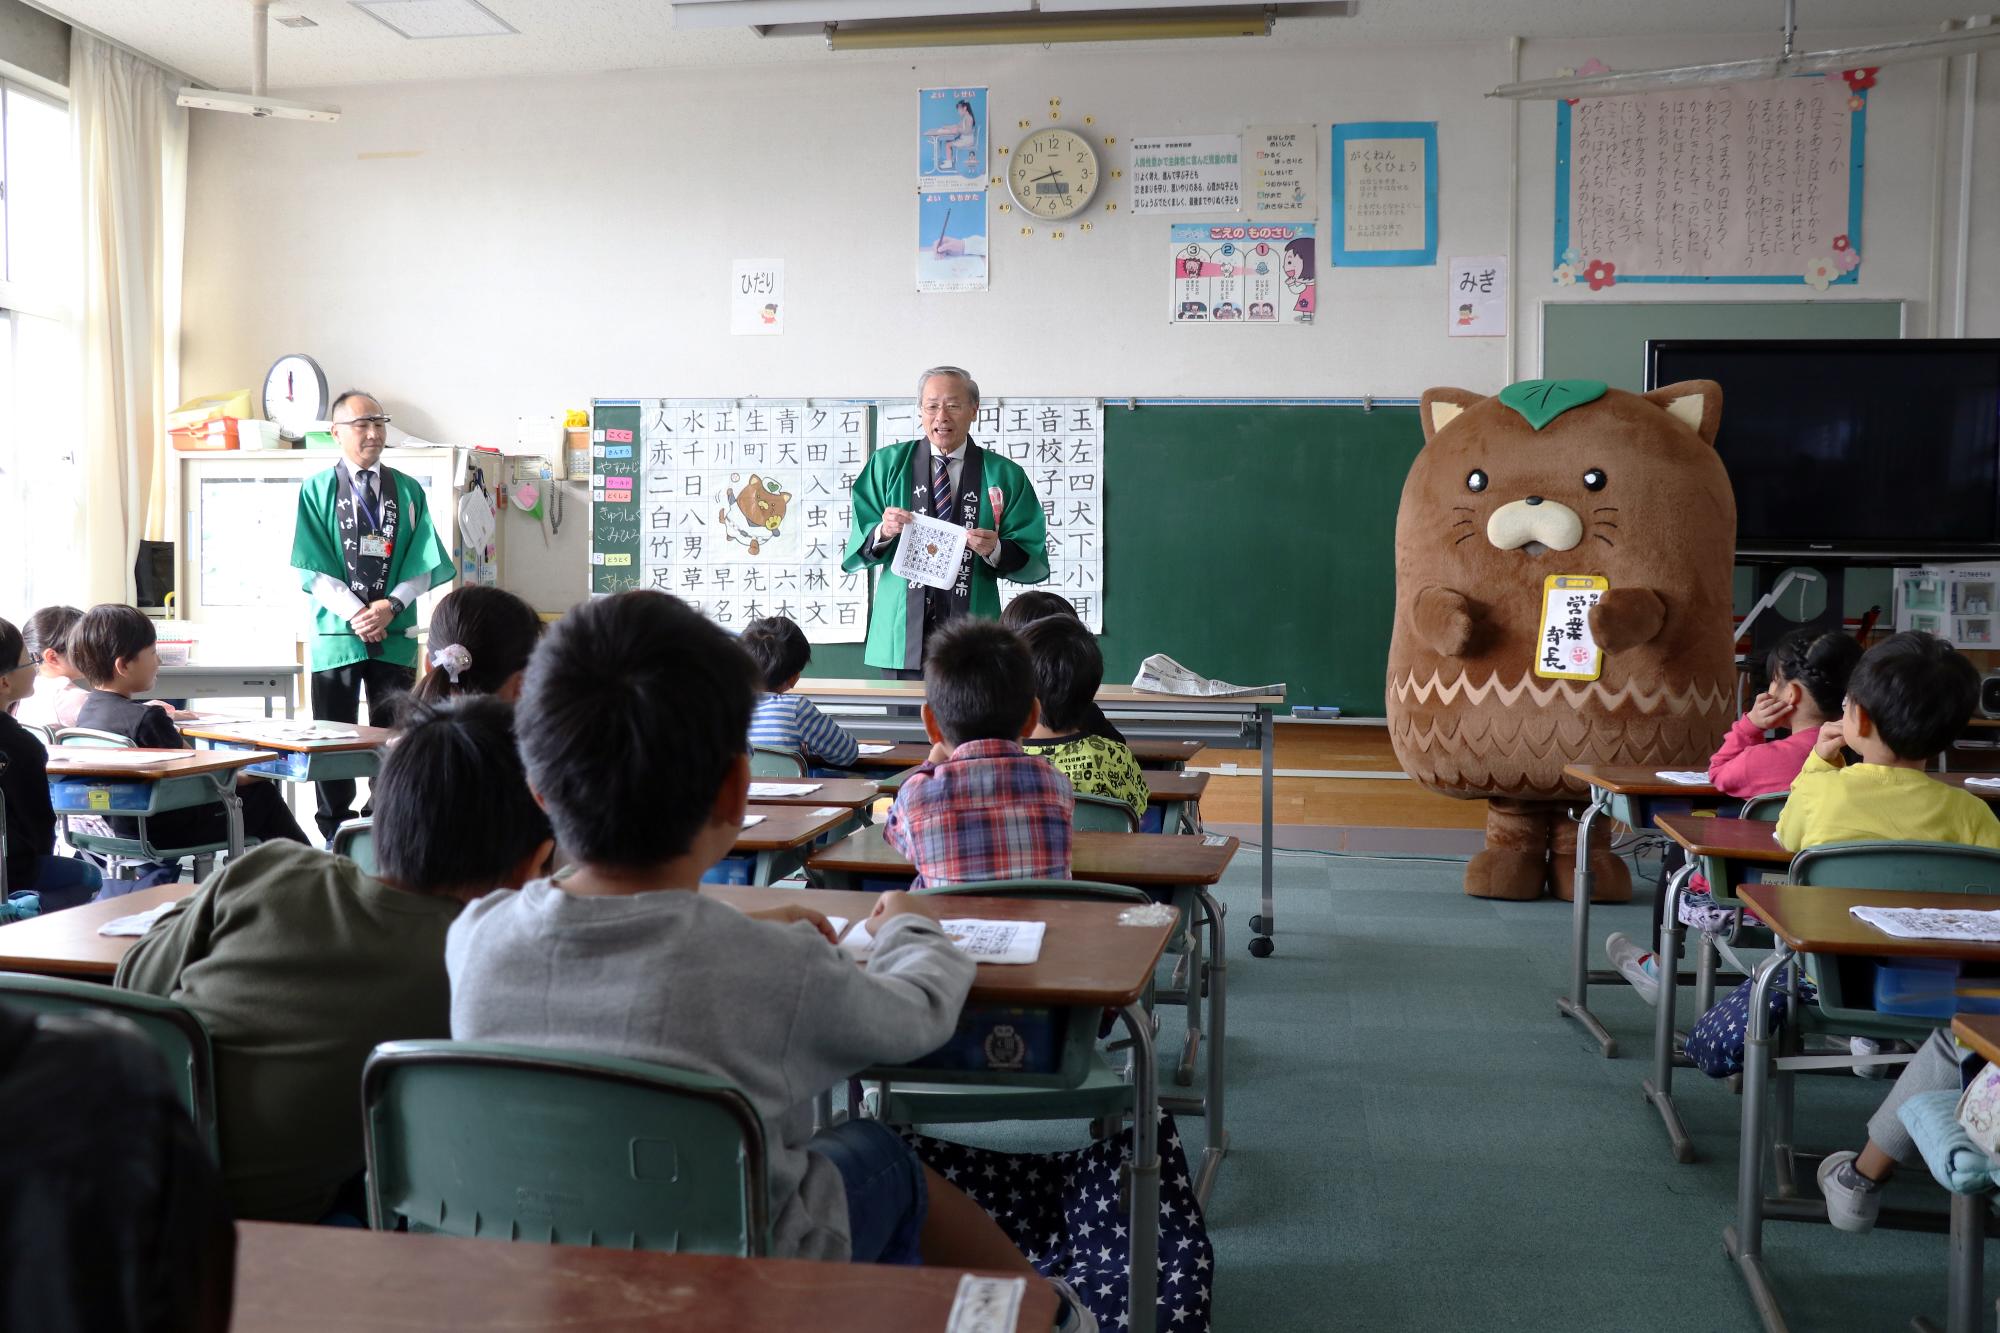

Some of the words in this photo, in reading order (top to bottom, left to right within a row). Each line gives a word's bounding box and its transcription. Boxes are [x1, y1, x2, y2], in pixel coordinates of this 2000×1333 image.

[1034, 142, 1044, 153] 11
[1049, 139, 1060, 150] 12
[1067, 142, 1072, 152] 1
[1351, 151, 1396, 161] がくねん
[1023, 154, 1034, 165] 10
[1076, 152, 1085, 164] 2
[1363, 161, 1418, 174] もくひょう
[1018, 170, 1026, 181] 9
[1081, 168, 1089, 180] 3
[1023, 186, 1031, 197] 8
[1076, 184, 1084, 194] 4
[1034, 196, 1043, 208] 7
[1049, 200, 1057, 211] 6
[1064, 196, 1073, 207] 5
[1210, 226, 1245, 241] こえの
[1248, 225, 1295, 241] ものさし
[741, 271, 775, 295] ひだり
[1459, 268, 1497, 294] みぎ
[653, 410, 674, 433] 人
[683, 409, 705, 434] 水
[713, 411, 736, 433] 正
[744, 409, 769, 433] 生
[775, 408, 800, 435] 青
[810, 408, 828, 431] 夕
[839, 410, 862, 434] 石
[976, 407, 1001, 434] 円
[1005, 408, 1033, 433] 王
[1036, 407, 1064, 433] 音
[1068, 408, 1095, 432] 玉
[649, 440, 673, 466] 赤
[682, 440, 705, 467] 千
[715, 440, 734, 465] 川
[743, 442, 768, 465] 町
[776, 442, 799, 465] 天
[806, 443, 828, 462] 田
[837, 441, 862, 465] 土
[1006, 441, 1031, 461] 口
[1036, 437, 1064, 464] 校
[1068, 438, 1094, 464] 左
[648, 476, 674, 495] 二
[685, 474, 702, 497] 日
[808, 474, 831, 495] 入
[1036, 469, 1064, 497] 子
[1068, 473, 1095, 492] 四
[651, 504, 671, 530] 白
[679, 508, 706, 526] 八
[807, 504, 828, 528] 虫
[1068, 500, 1095, 526] 犬
[338, 497, 366, 591] やはたいぬ
[649, 535, 673, 560] 竹
[683, 535, 702, 560] 男
[804, 537, 829, 560] 大
[1067, 532, 1095, 559] 下
[649, 567, 673, 591] 足
[680, 566, 705, 592] 草
[711, 568, 735, 592] 早
[743, 566, 767, 592] 先
[774, 568, 798, 590] 六
[803, 567, 830, 591] 林
[1067, 563, 1095, 589] 小
[713, 599, 733, 623] 名
[804, 600, 829, 625] 文
[835, 601, 861, 625] 百
[1072, 595, 1093, 621] 耳
